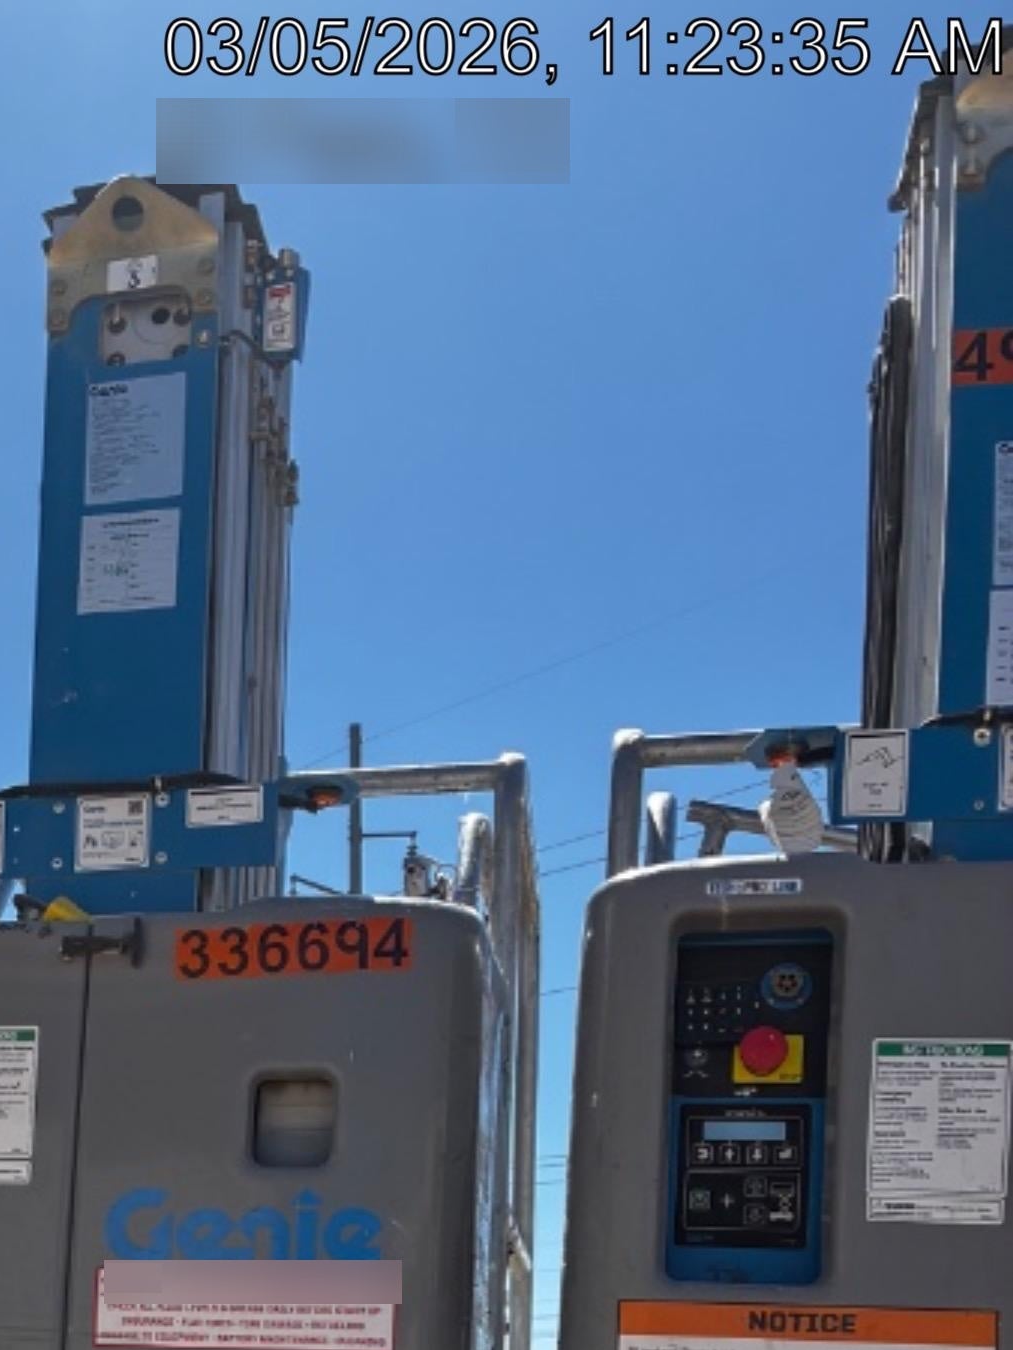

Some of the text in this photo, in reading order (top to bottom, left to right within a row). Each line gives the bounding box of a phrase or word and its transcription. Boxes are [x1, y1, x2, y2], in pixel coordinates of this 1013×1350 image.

[179, 918, 409, 979] 336694
[104, 1186, 382, 1259] Genie
[748, 1310, 857, 1333] NOTICE
